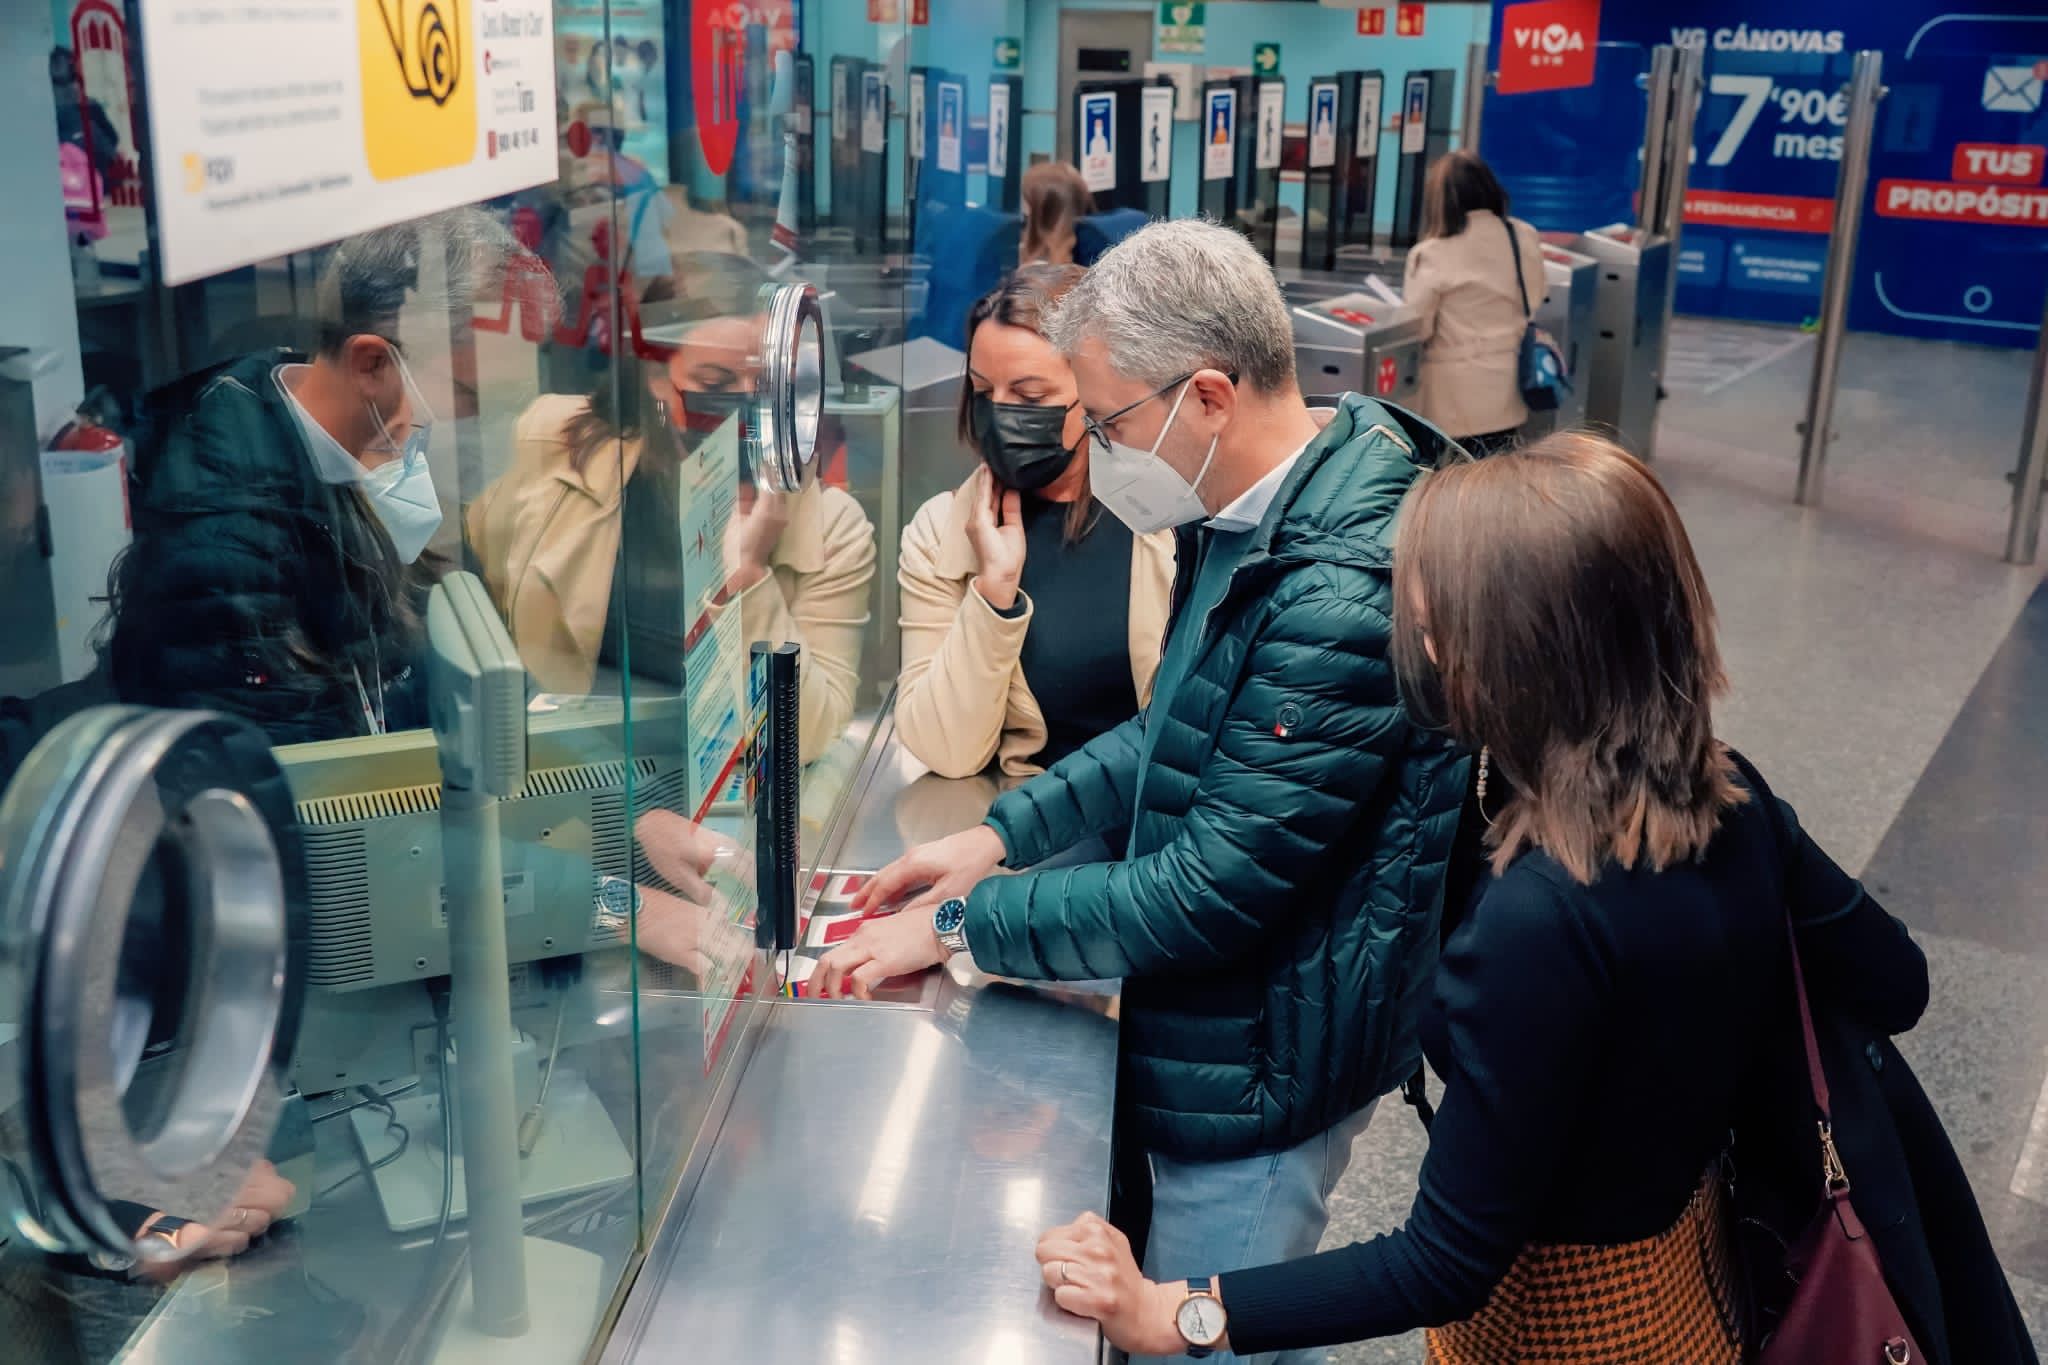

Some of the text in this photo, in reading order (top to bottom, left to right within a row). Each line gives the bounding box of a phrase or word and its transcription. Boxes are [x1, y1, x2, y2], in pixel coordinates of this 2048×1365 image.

[1513, 24, 1585, 53] VIVA
[1713, 23, 1845, 52] CÁNOVAS
[1966, 149, 2033, 176] TUS
